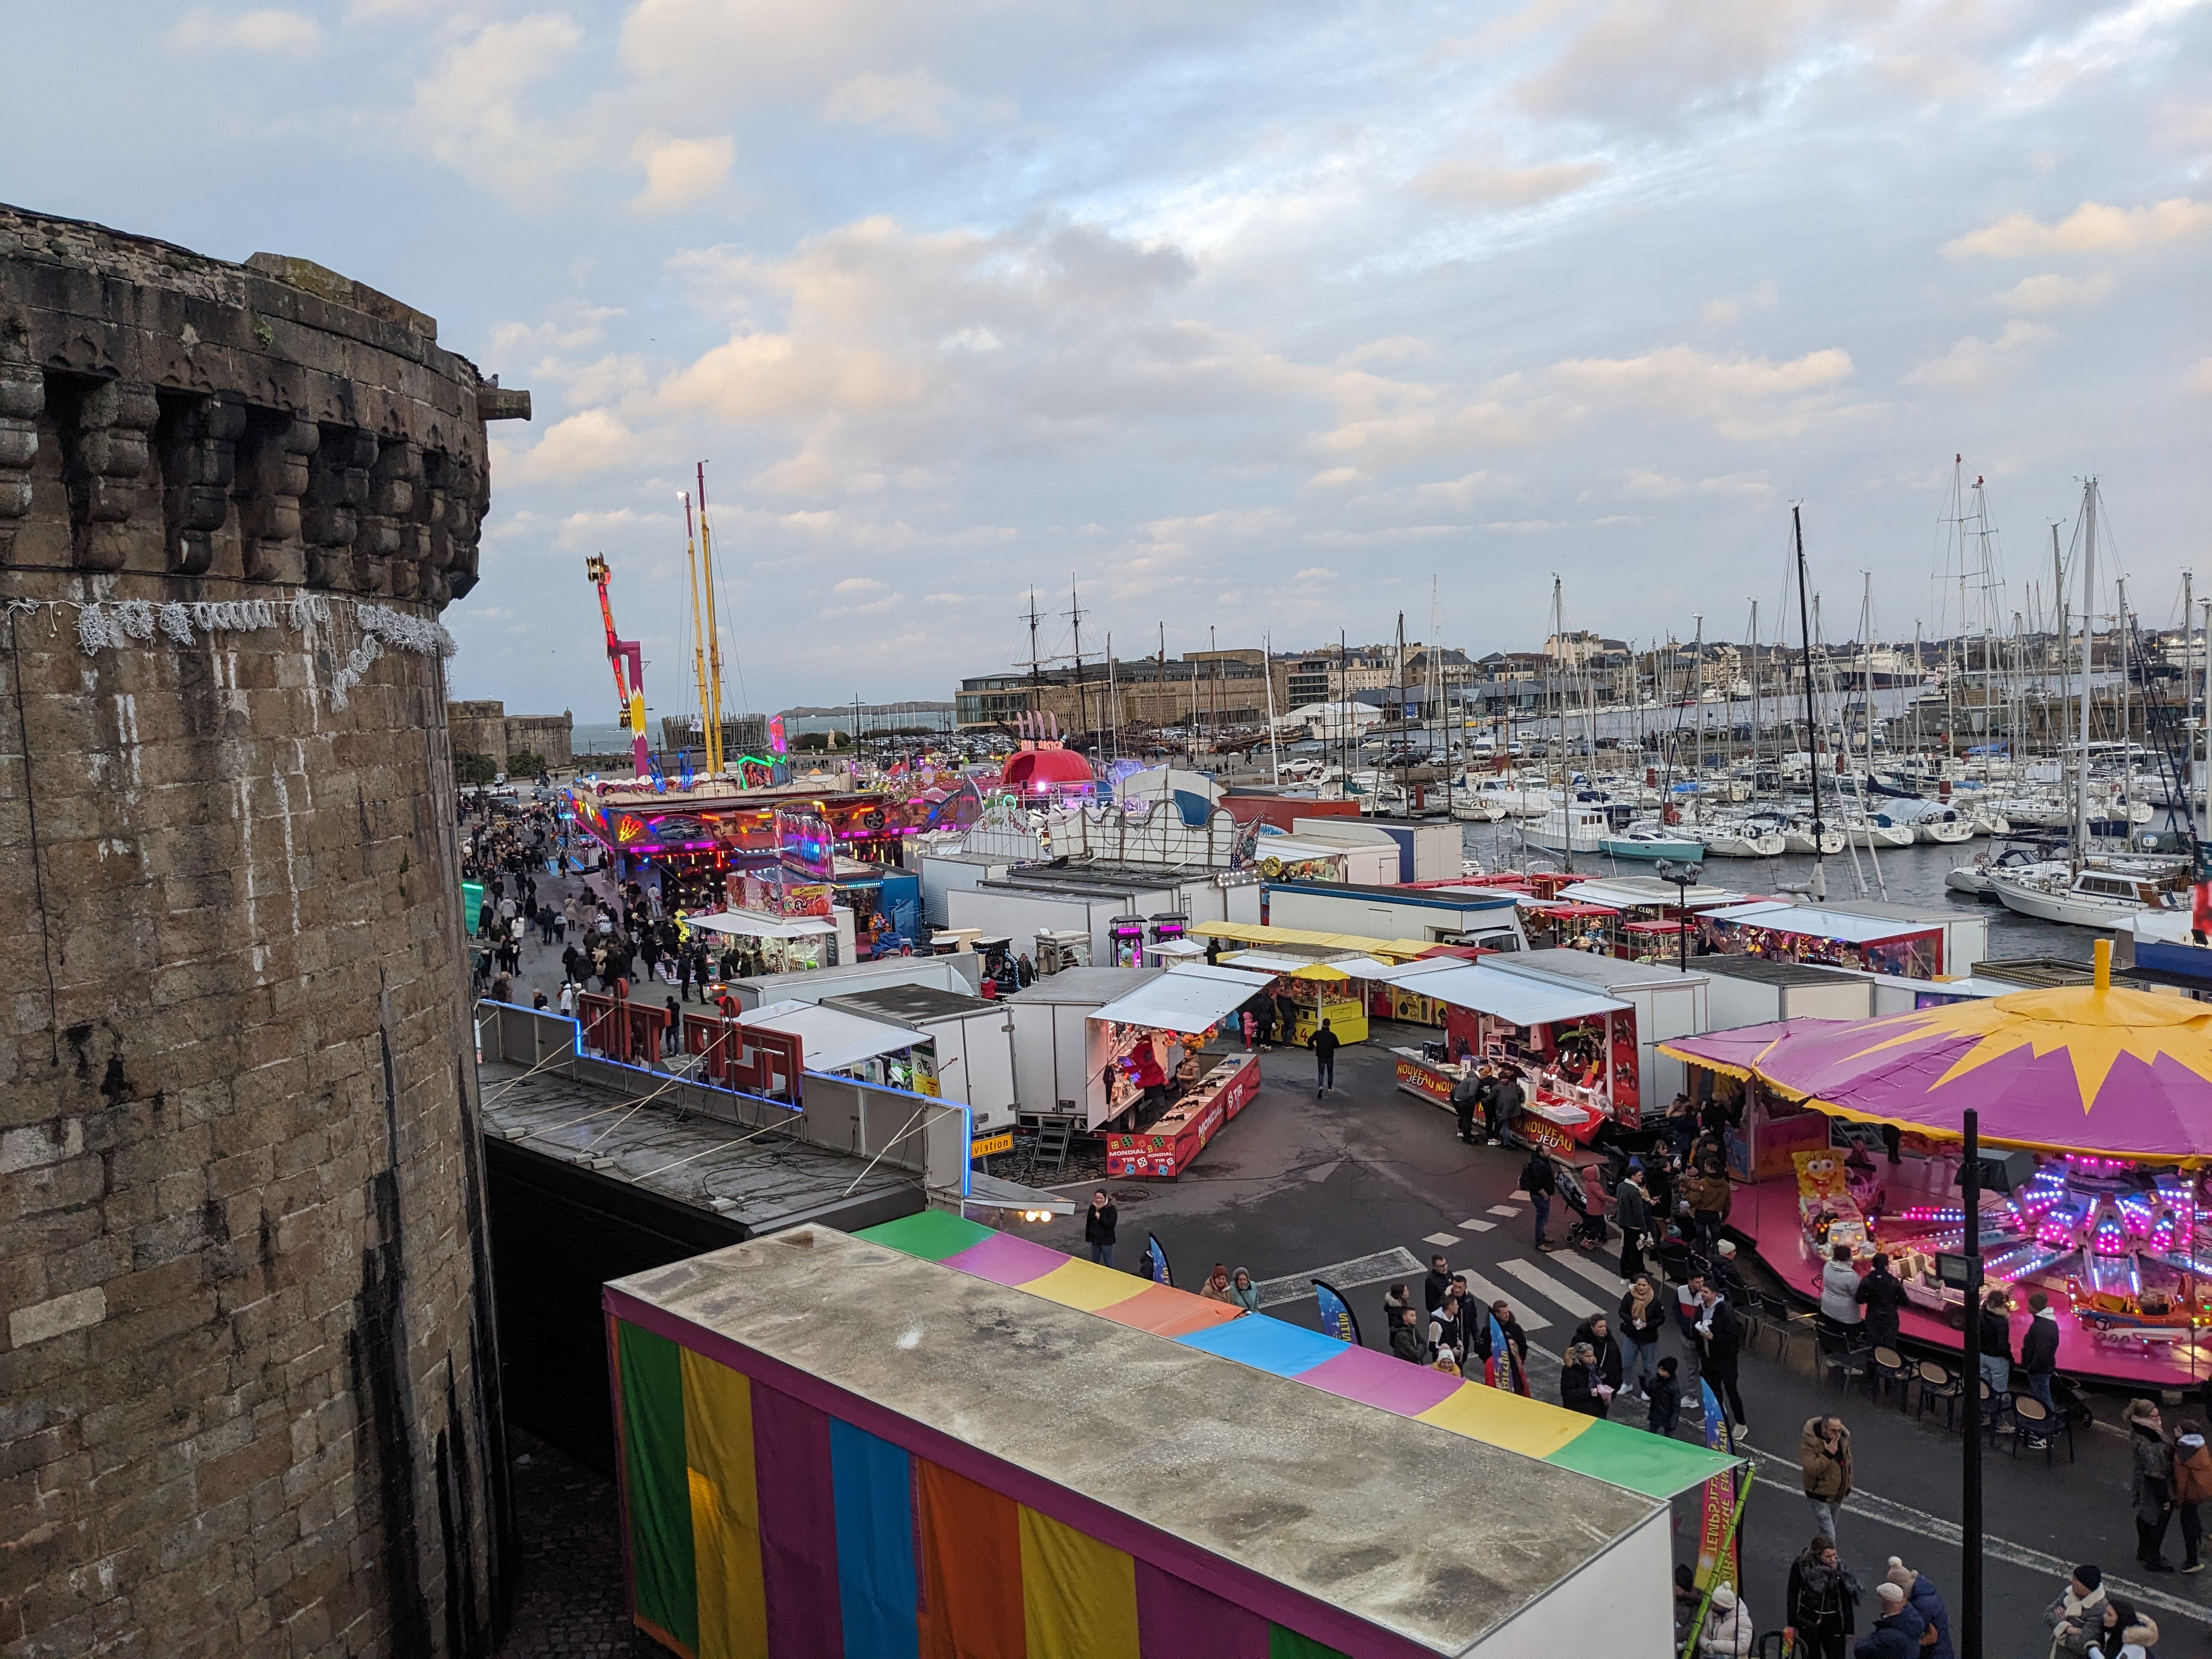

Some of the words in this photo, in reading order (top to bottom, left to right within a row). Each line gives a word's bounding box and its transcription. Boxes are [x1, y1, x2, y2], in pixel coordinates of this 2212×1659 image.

[799, 887, 823, 895] Sucettes
[1638, 906, 1655, 915] CLUB
[1397, 1064, 1435, 1089] NOUVEAU
[1435, 1081, 1456, 1093] NOU
[1406, 1075, 1425, 1086] JEU
[1233, 1084, 1243, 1101] TIR
[1523, 1121, 1573, 1152] NOUVEAU
[1536, 1134, 1560, 1148] JEU
[970, 1139, 1009, 1155] viation
[1109, 1148, 1146, 1157] MONDIAL
